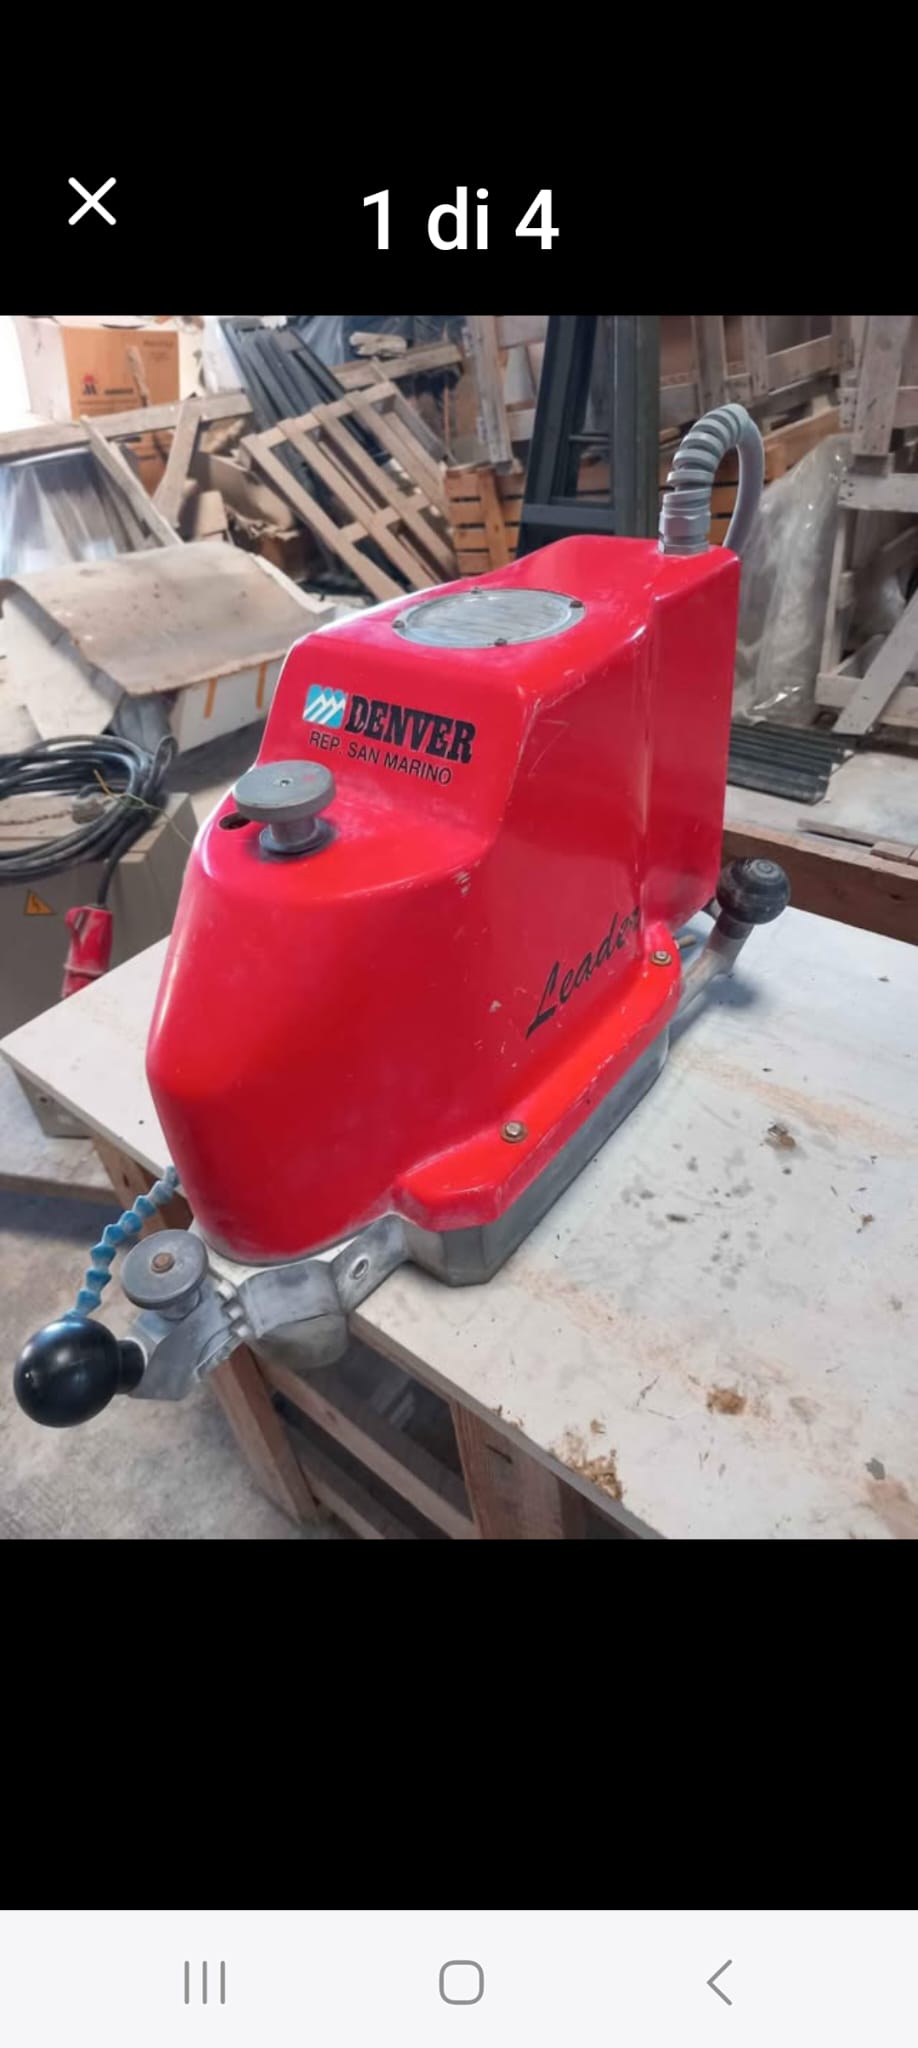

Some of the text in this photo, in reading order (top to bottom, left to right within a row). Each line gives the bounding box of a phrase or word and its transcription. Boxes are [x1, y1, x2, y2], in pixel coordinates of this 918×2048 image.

[309, 731, 452, 785] REP. SAN MARINO
[344, 695, 476, 764] DENVER
[525, 905, 641, 1040] Leader
